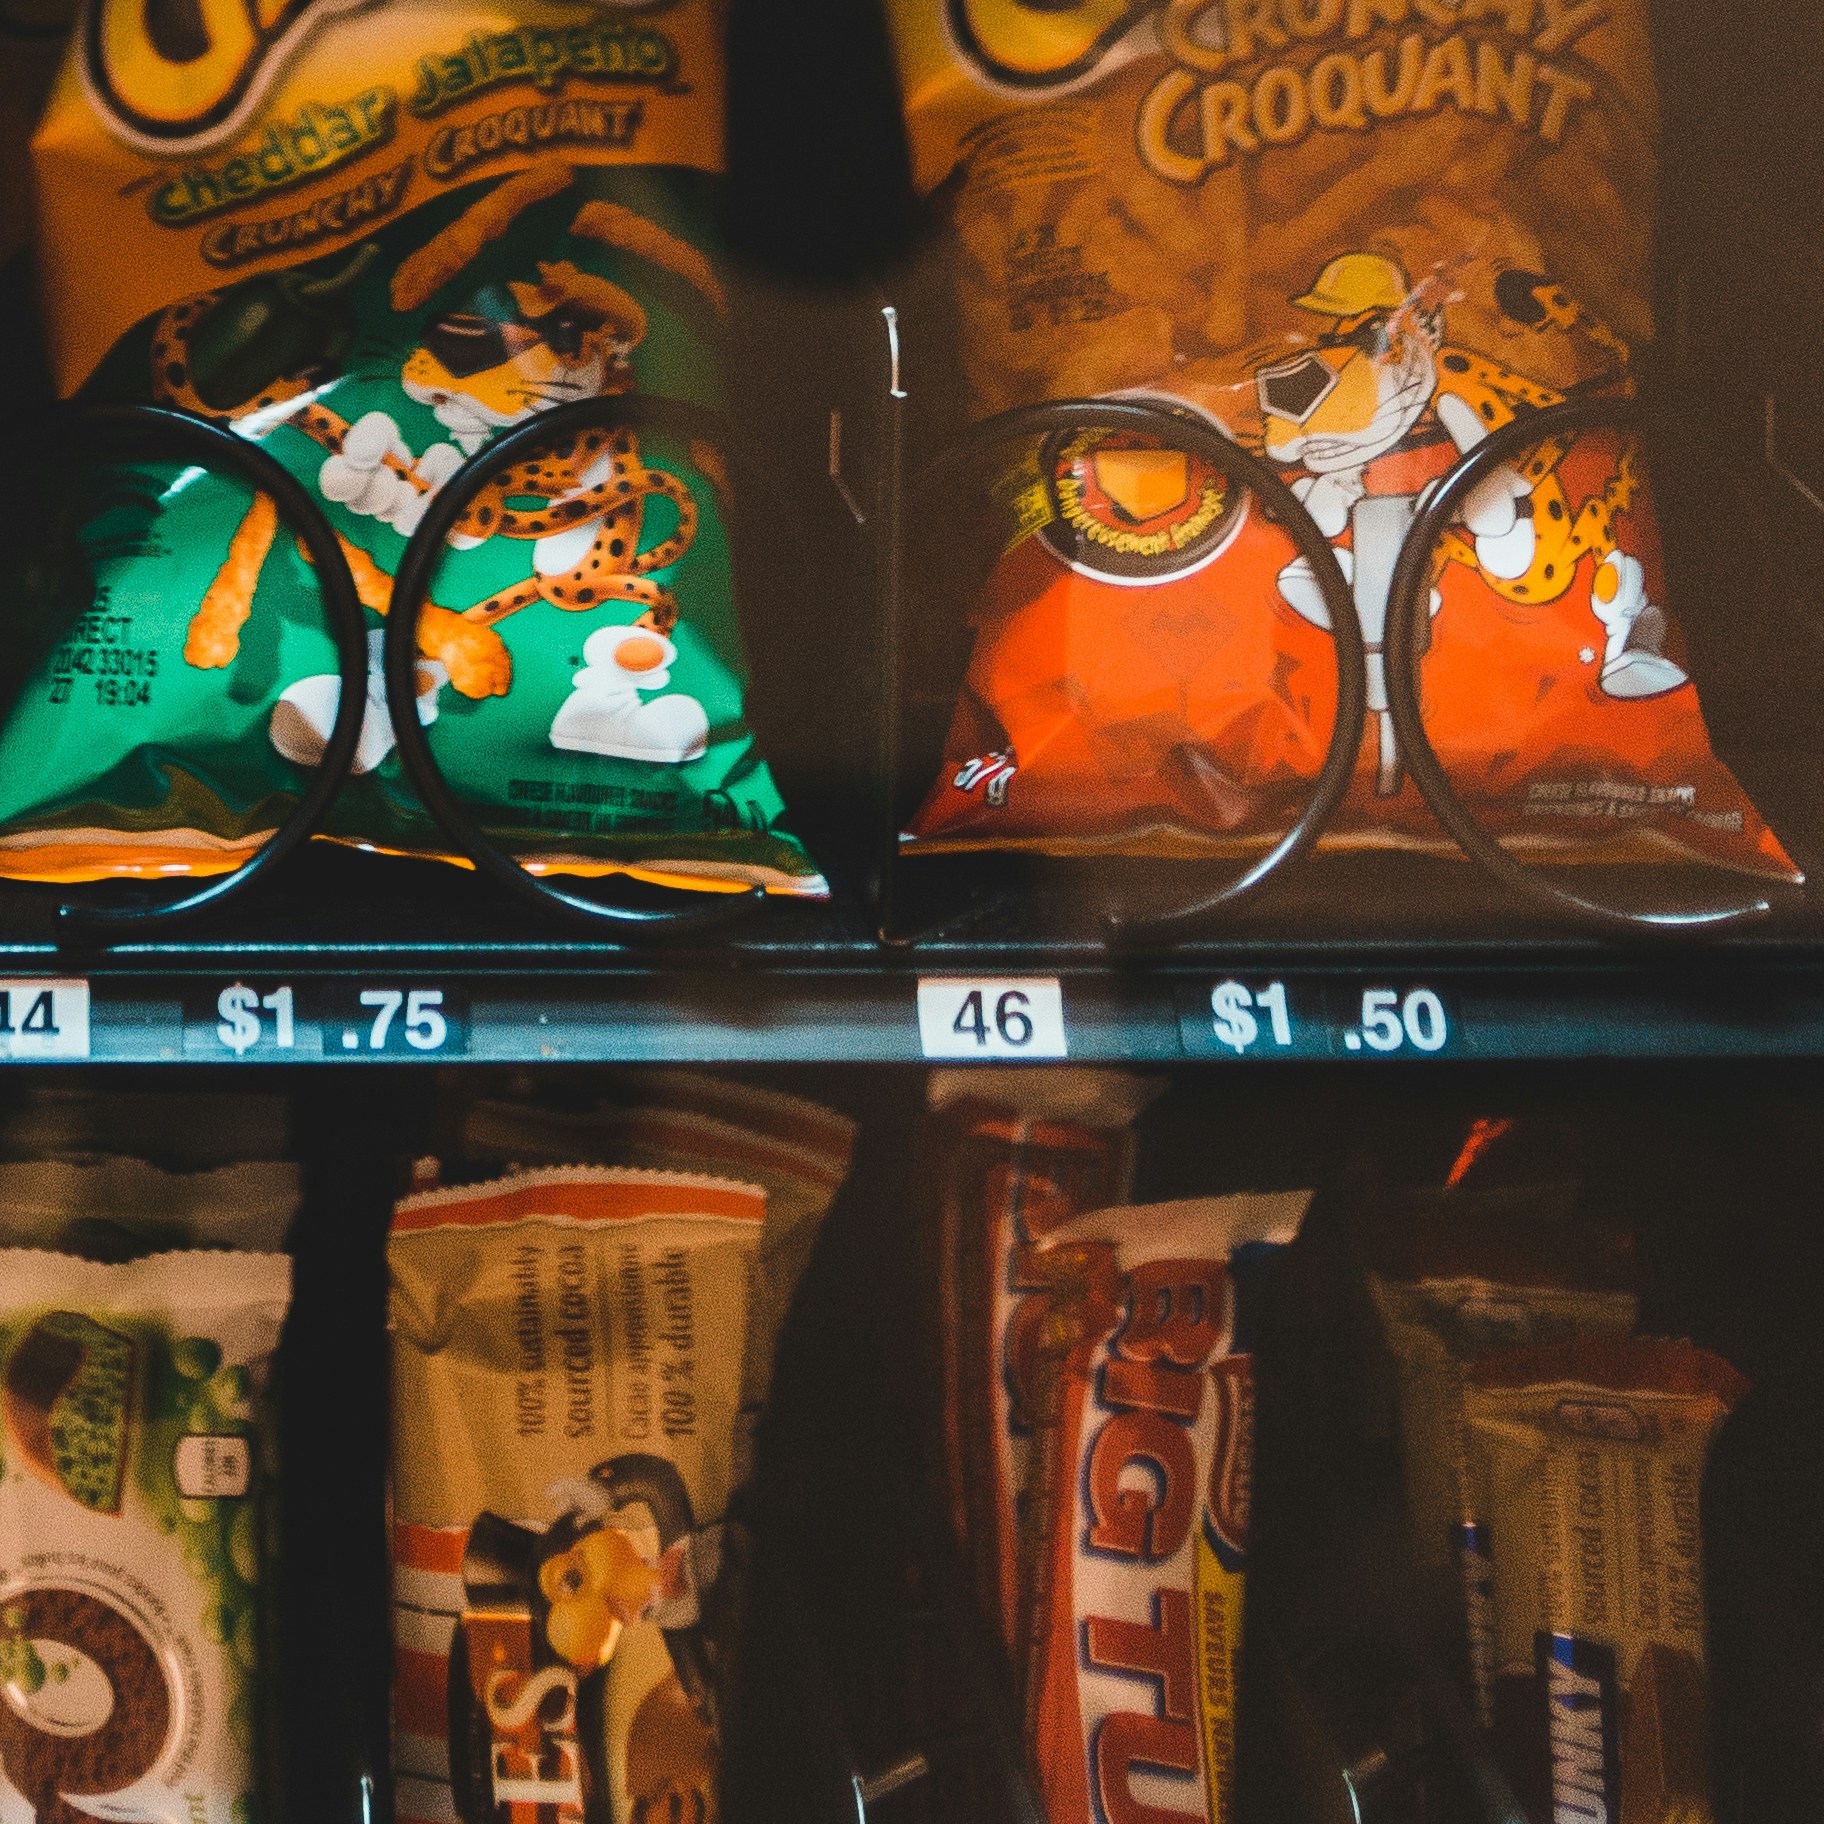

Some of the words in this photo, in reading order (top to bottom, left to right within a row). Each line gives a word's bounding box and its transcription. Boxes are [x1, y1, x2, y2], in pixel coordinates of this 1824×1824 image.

[1134, 32, 1596, 184] CROQUANT
[217, 984, 296, 1055] $1
[340, 990, 447, 1051] .75
[952, 990, 1034, 1047] 46
[1211, 981, 1291, 1047] $1
[1344, 988, 1449, 1051] .50
[1082, 1256, 1232, 1565] BIG
